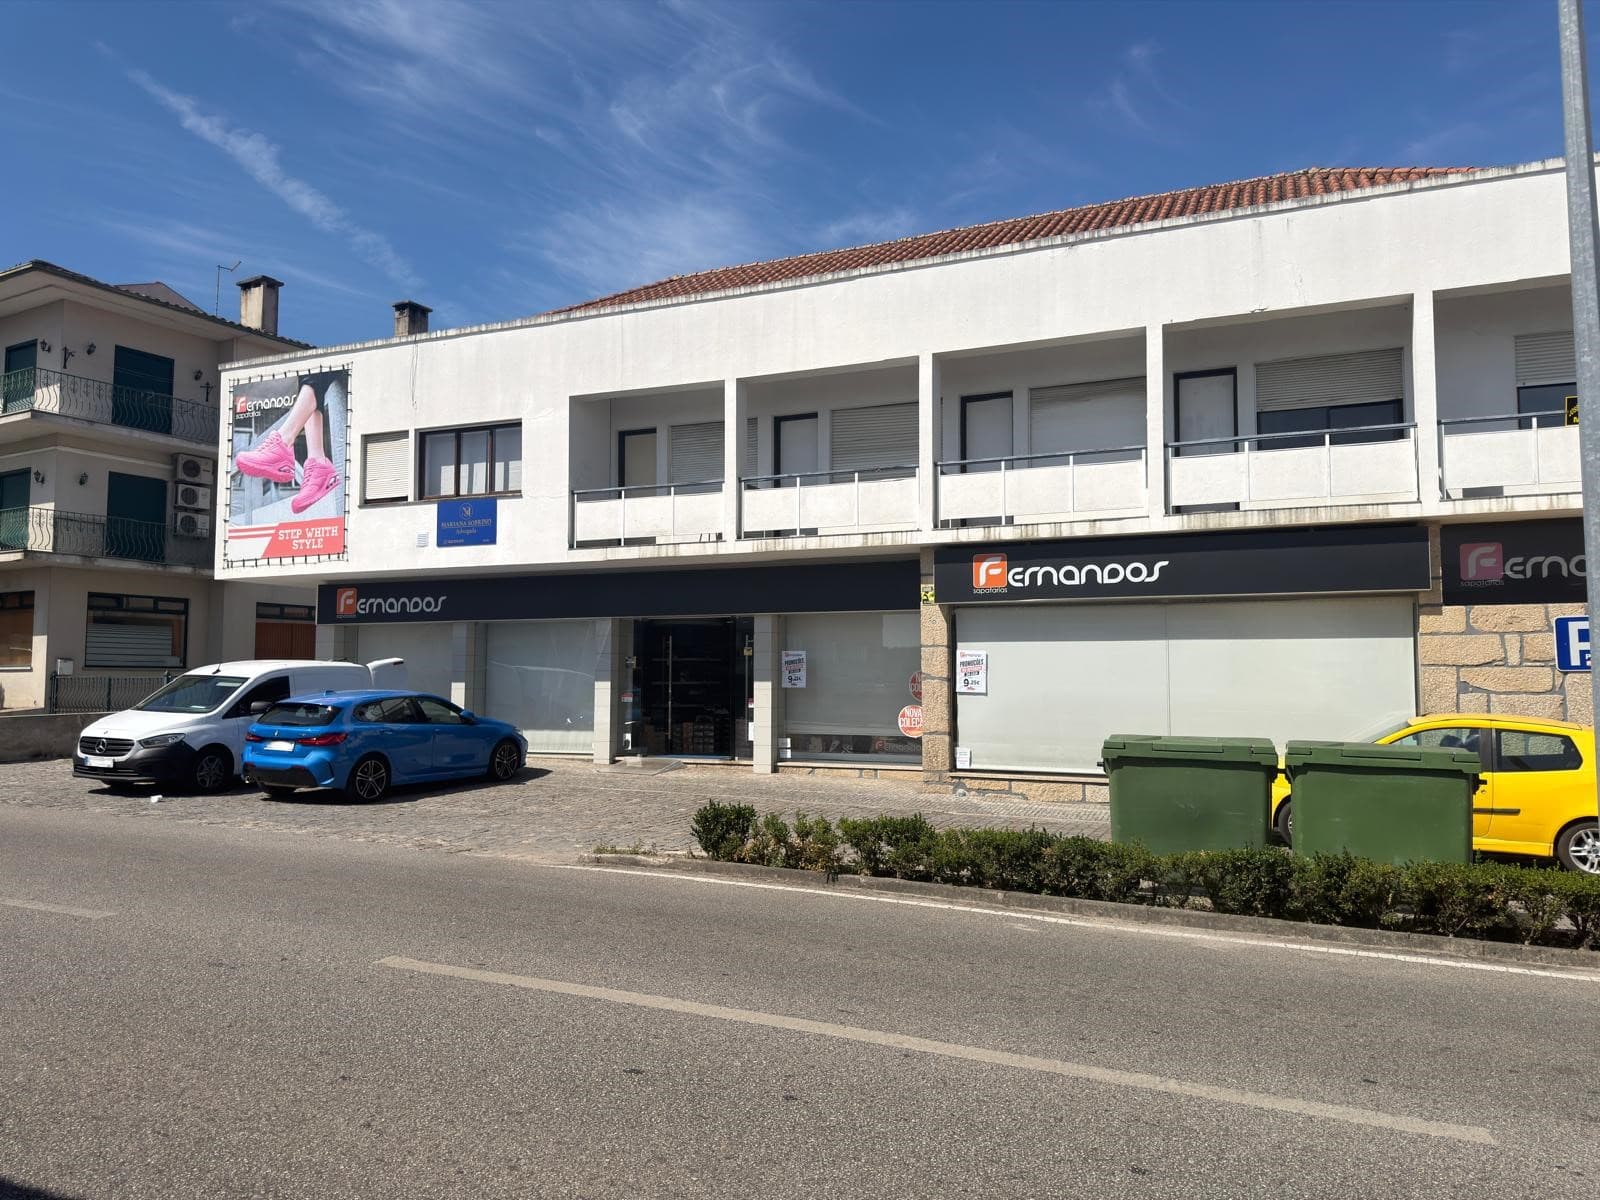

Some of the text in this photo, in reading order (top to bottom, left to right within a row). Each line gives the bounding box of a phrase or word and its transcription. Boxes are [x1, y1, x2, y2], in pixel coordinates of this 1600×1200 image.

[278, 525, 338, 540] STEP WHITH
[292, 538, 323, 550] STYLE
[979, 556, 1170, 588] Fernandos
[973, 586, 1008, 595] sapatarias
[339, 590, 447, 614] Fernandos
